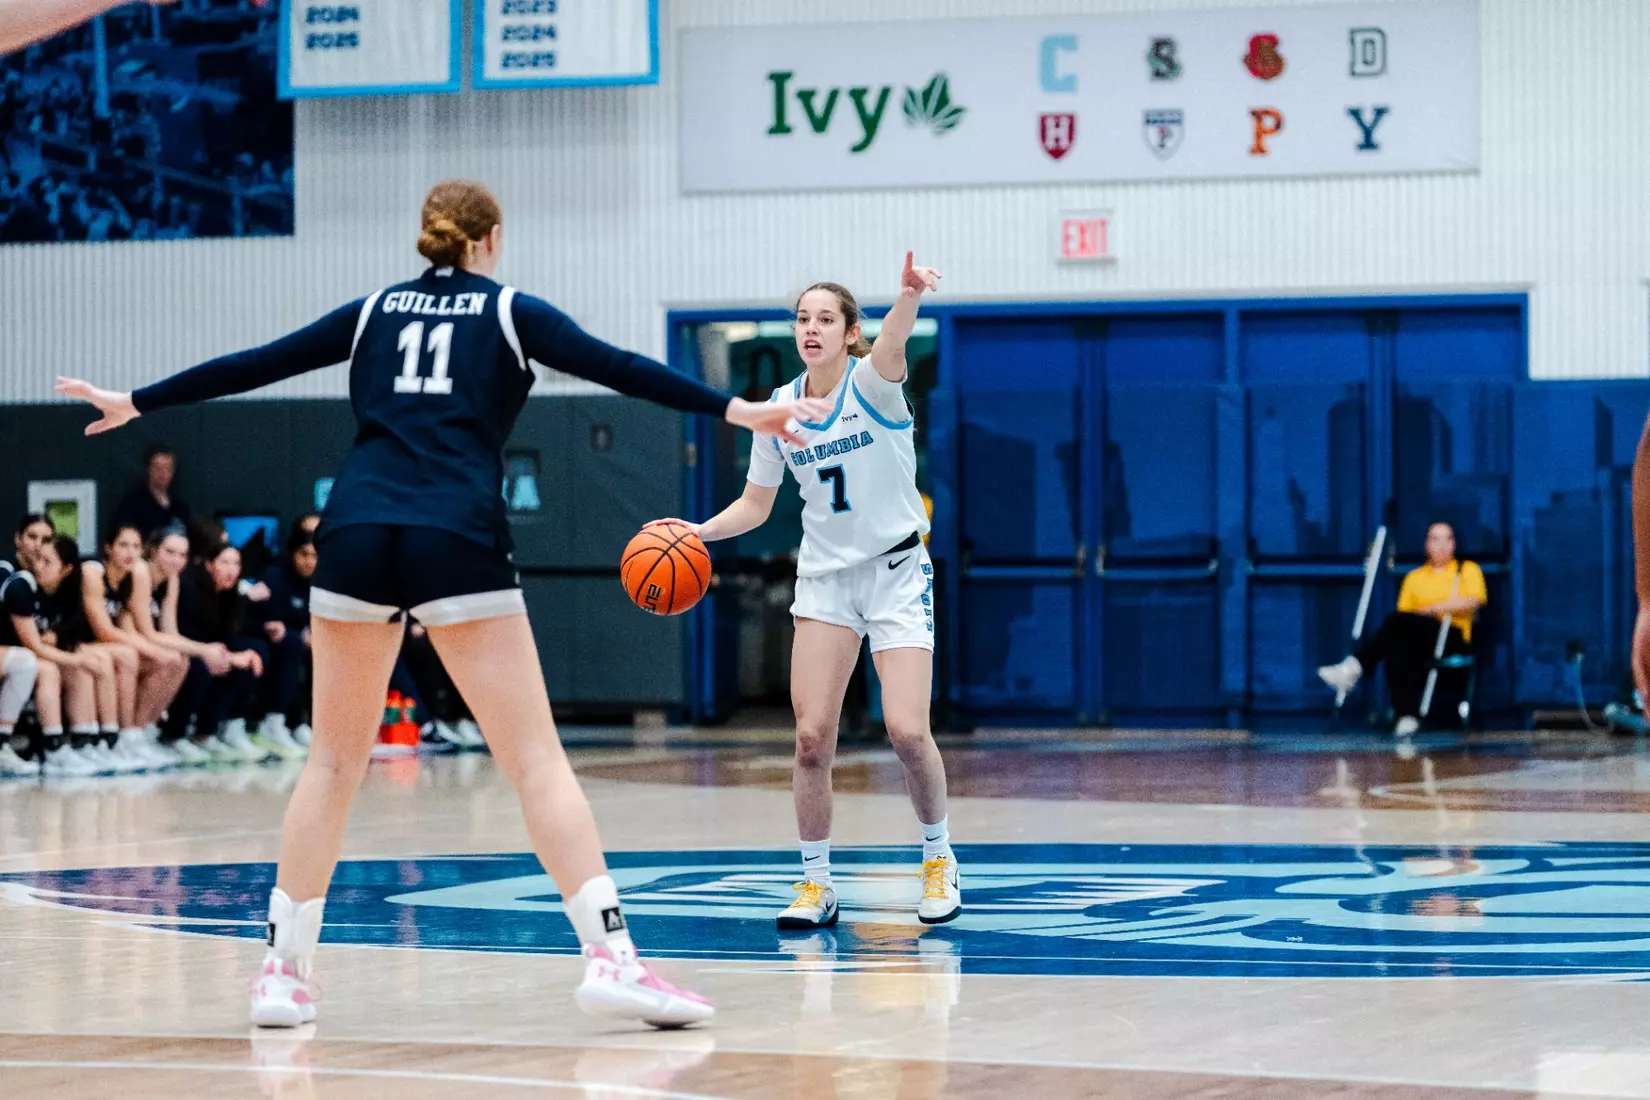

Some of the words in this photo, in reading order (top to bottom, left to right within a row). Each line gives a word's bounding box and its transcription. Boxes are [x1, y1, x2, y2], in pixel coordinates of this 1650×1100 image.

[1038, 34, 1078, 92] C
[1349, 27, 1387, 77] D
[767, 71, 891, 153] Ivy
[1043, 114, 1072, 149] H
[1250, 108, 1284, 155] P
[1347, 106, 1389, 151] Y
[1062, 219, 1107, 256] EXIT
[382, 290, 487, 316] GUILLEN
[393, 320, 454, 394] 11
[816, 463, 852, 514] 7
